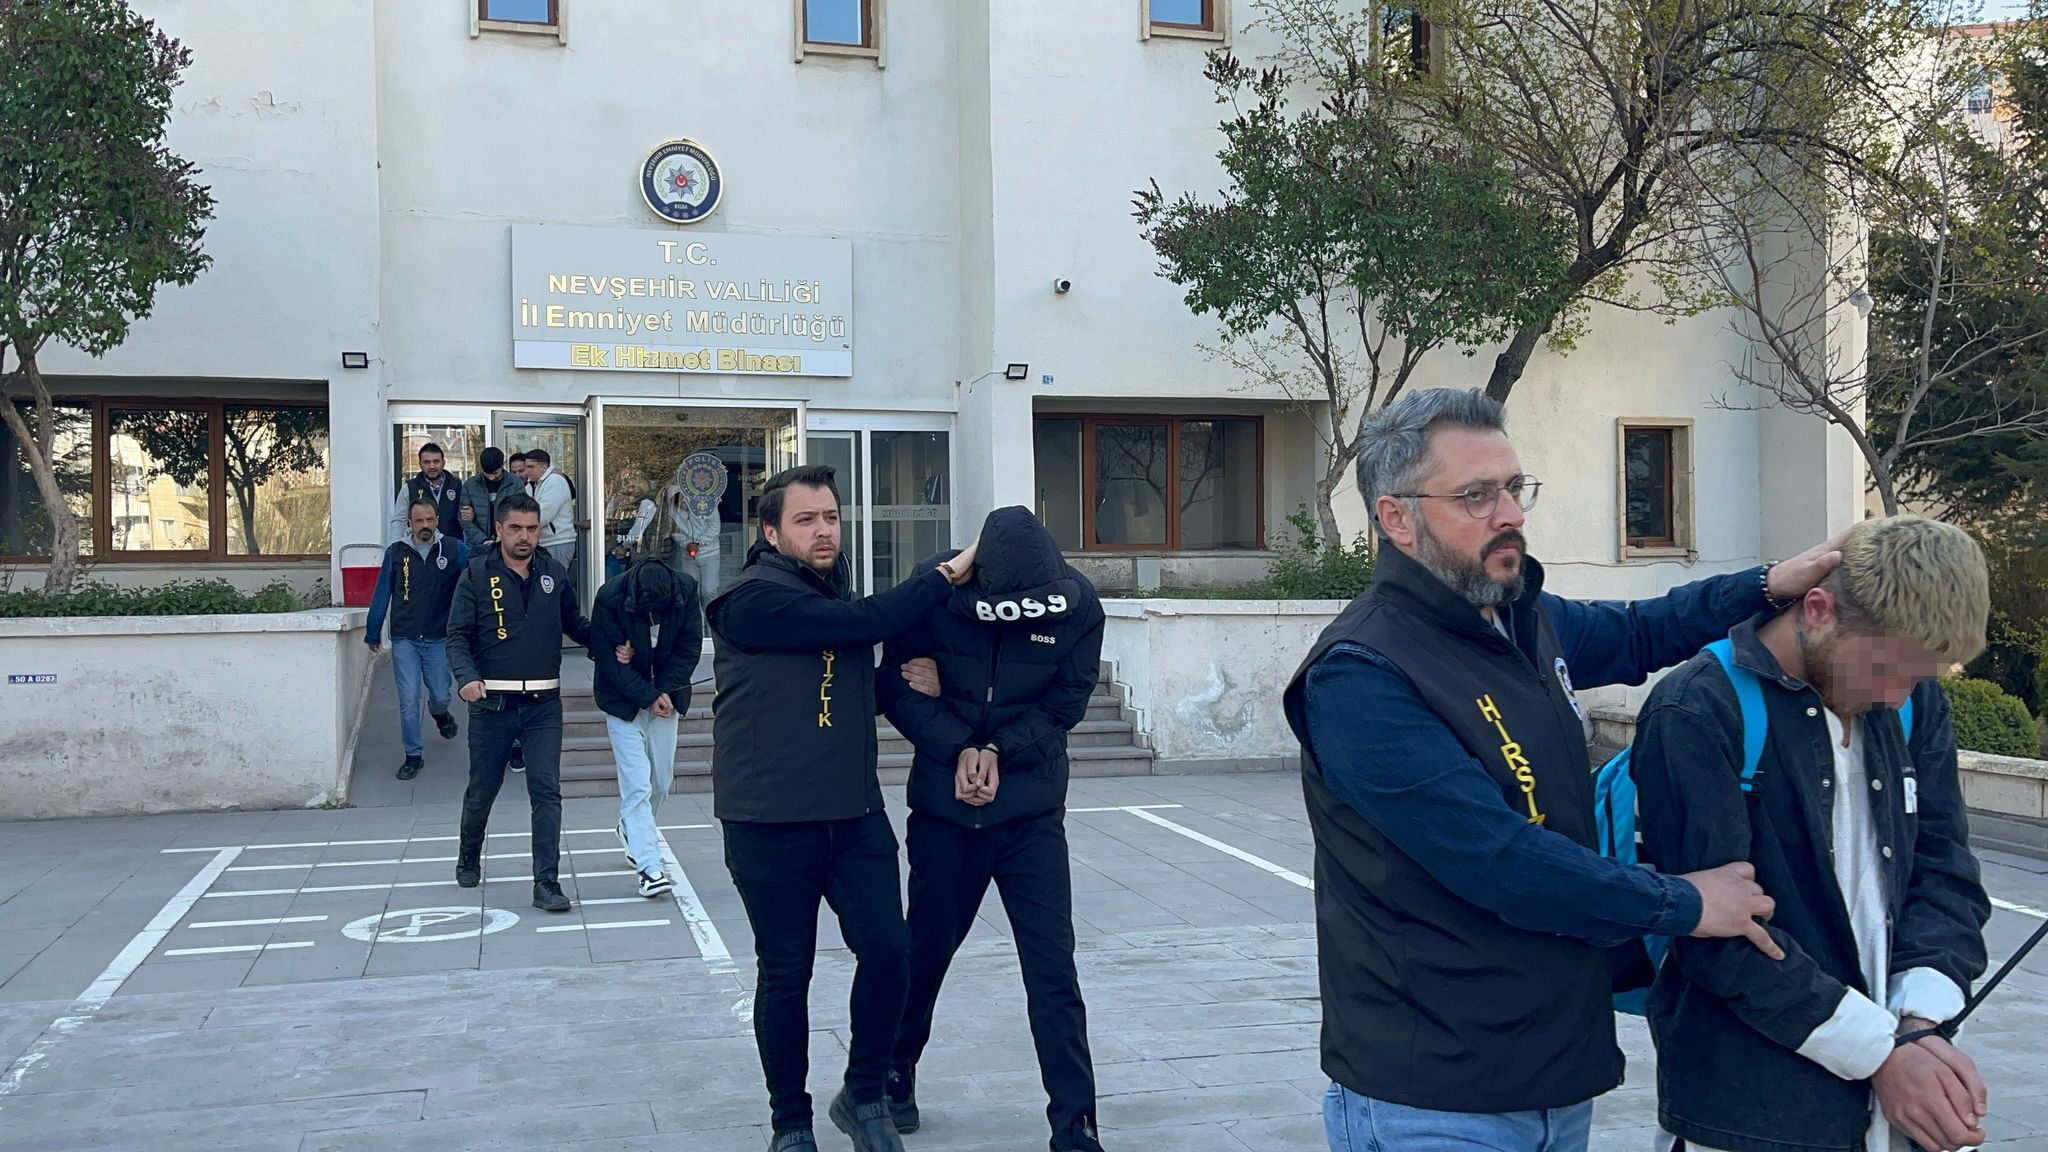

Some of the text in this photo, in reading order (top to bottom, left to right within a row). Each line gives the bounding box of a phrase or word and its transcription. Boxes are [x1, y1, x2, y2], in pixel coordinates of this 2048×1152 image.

[646, 152, 662, 178] NEVŞEHİR
[663, 145, 688, 154] EMNİYET
[657, 240, 718, 266] T.C.
[548, 274, 820, 304] NEVŞEHİR VALİLİĞİ
[520, 298, 846, 342] İl Emniyet Müdürlüğü
[570, 344, 609, 368] Ek
[490, 576, 508, 640] POLİS
[976, 594, 1068, 621] BOSS
[1030, 634, 1056, 644] BOSS
